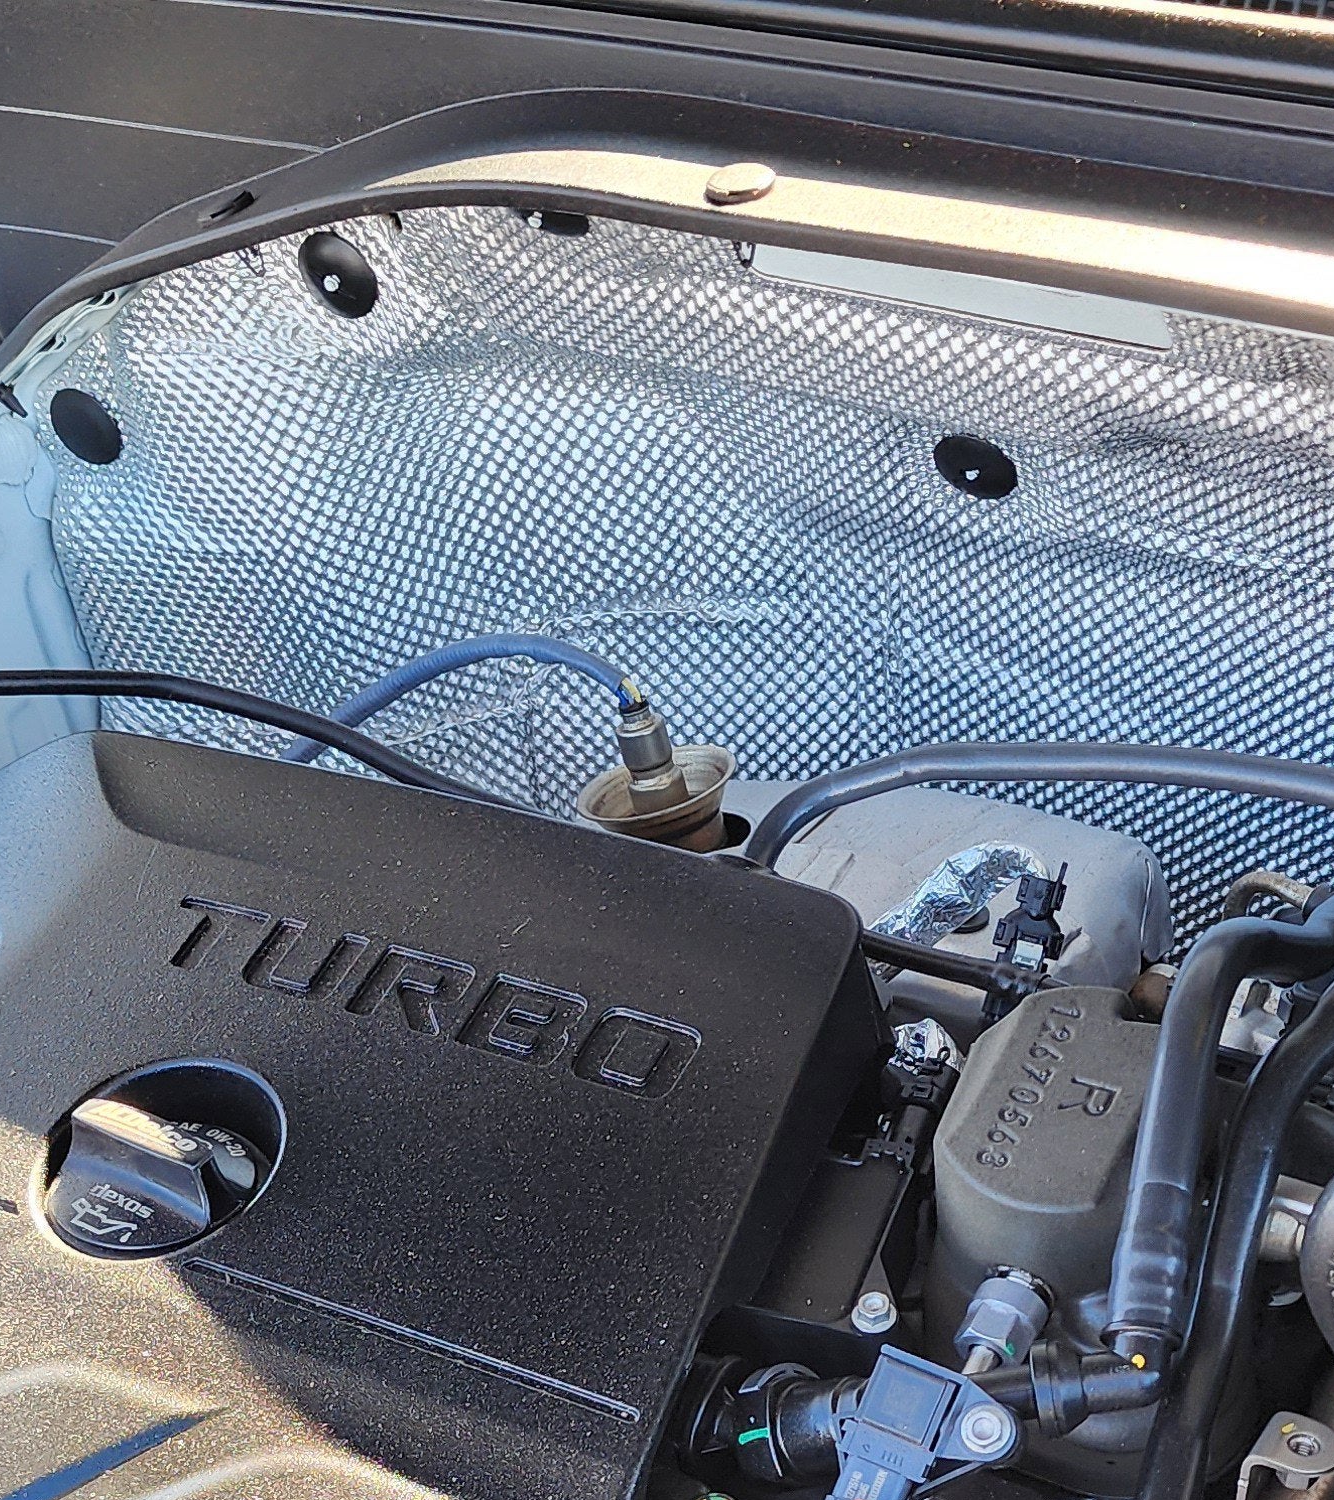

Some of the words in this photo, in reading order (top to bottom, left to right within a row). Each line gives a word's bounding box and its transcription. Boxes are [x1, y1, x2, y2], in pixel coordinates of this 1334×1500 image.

[170, 896, 702, 1099] TURBO
[1058, 1076, 1121, 1117] R
[88, 1182, 155, 1220] dexos
